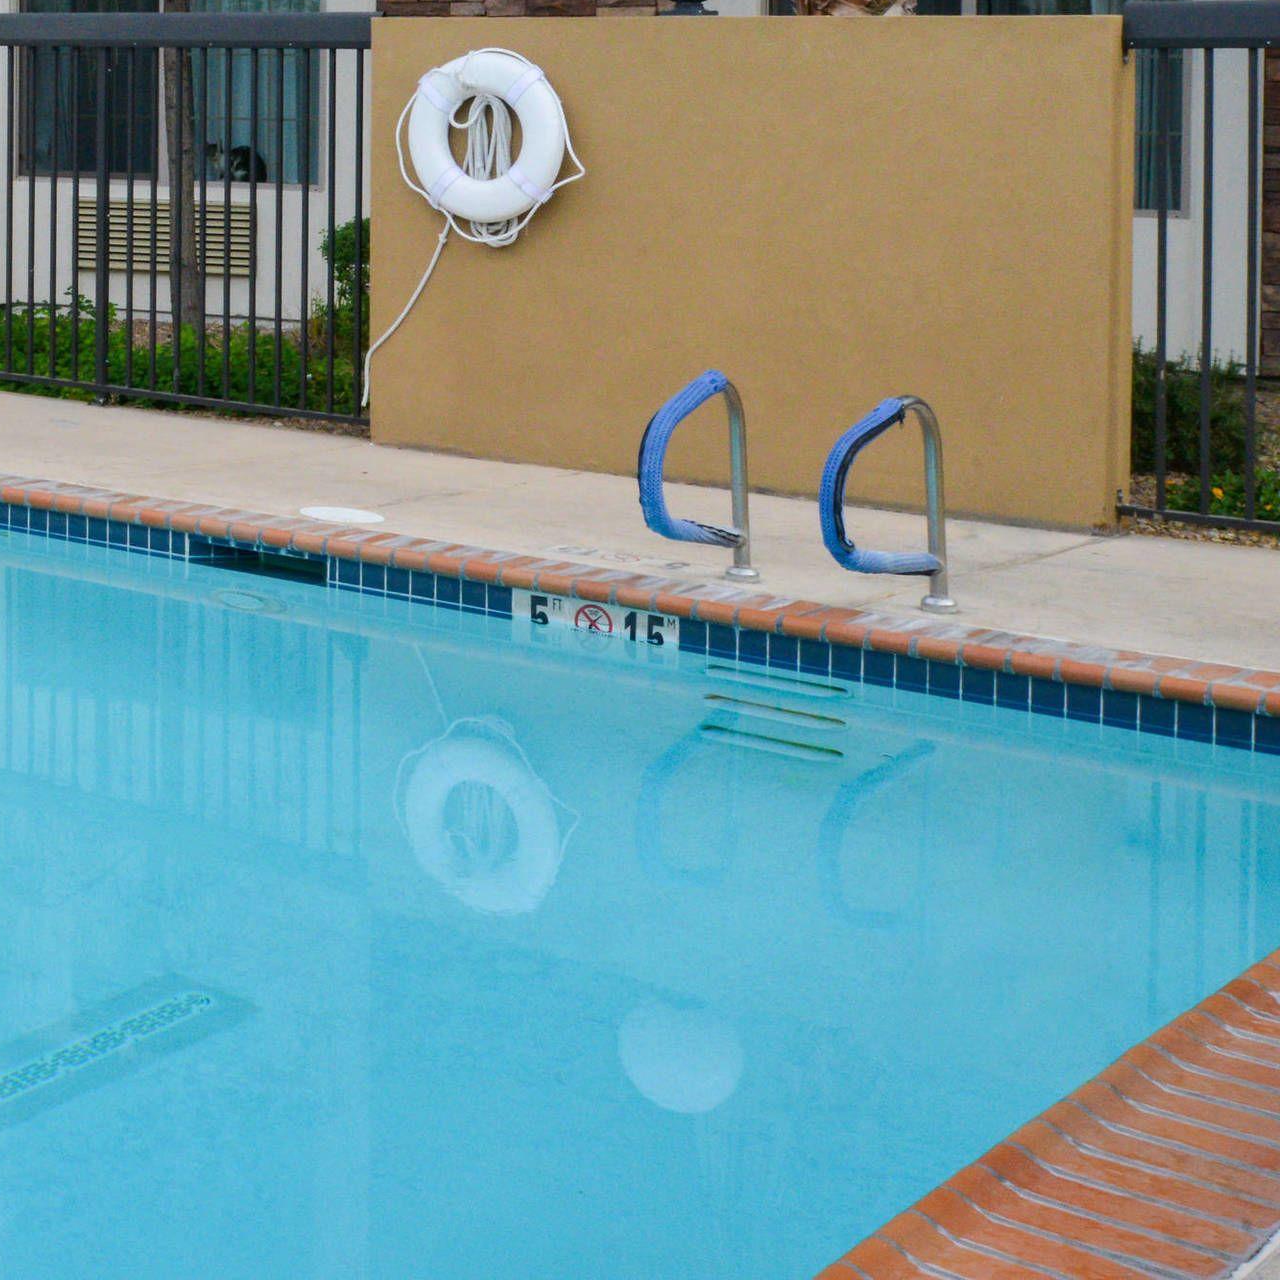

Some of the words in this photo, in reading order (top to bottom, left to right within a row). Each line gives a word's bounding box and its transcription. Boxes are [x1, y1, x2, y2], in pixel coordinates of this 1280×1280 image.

[530, 595, 549, 625] 5
[552, 598, 562, 611] FT
[666, 617, 676, 630] M
